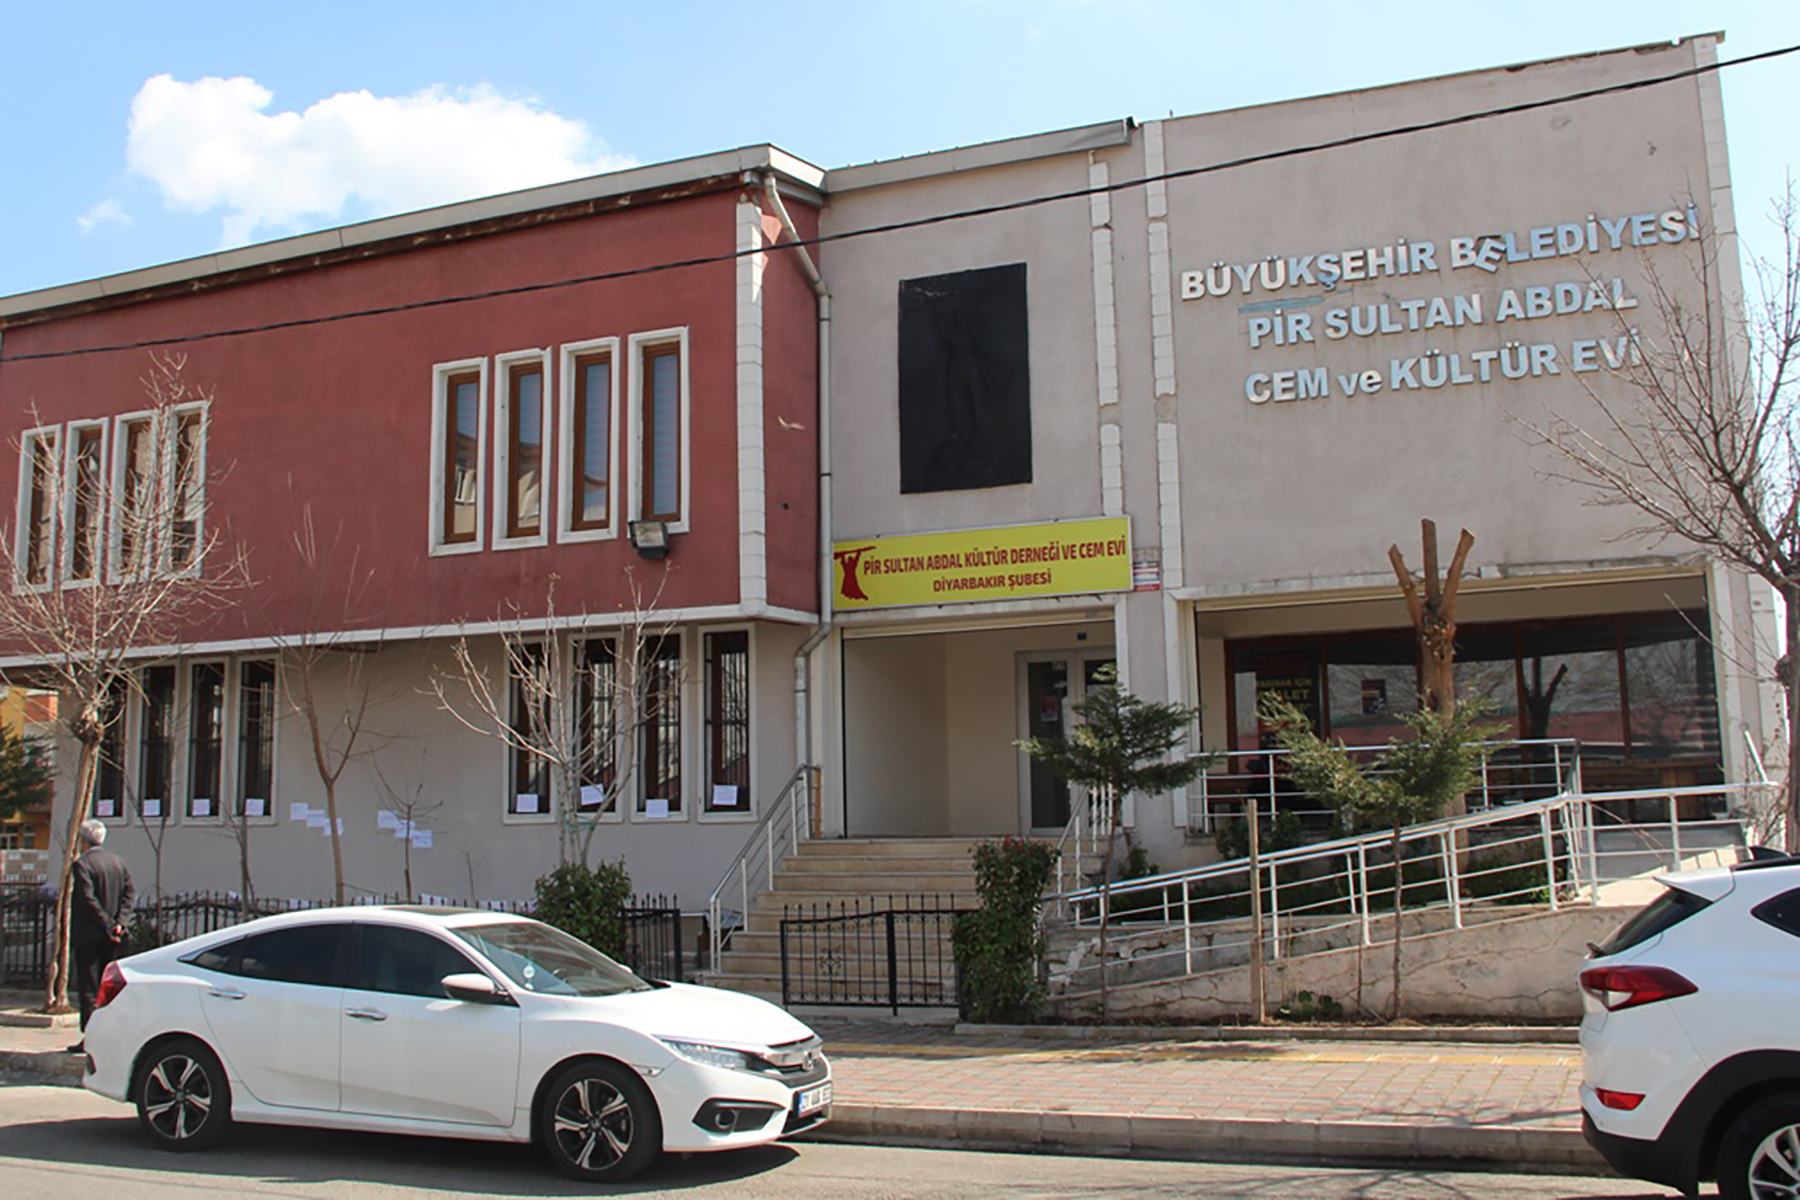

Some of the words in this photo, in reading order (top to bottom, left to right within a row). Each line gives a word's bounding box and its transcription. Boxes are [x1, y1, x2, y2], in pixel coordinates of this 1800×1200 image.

[1181, 238, 1439, 301] BÜYÜKŞEHİR
[1450, 201, 1700, 273] BELEDİYESİ
[1248, 308, 1315, 349] PİR
[1325, 293, 1483, 339] SULTAN
[1496, 277, 1638, 322] ABDAL
[1245, 367, 1329, 404] CEM
[1337, 369, 1383, 398] ve
[1390, 341, 1561, 391] KÜLTÜR
[1572, 327, 1642, 373] EVİ
[864, 555, 882, 576] PİR
[883, 557, 925, 574] SULTAN
[926, 553, 963, 571] ABDAL
[964, 546, 1009, 568] KÜLTÜR
[1010, 541, 1060, 565] DERNEĞİ
[1062, 543, 1078, 560] VE
[1078, 541, 1105, 559] CEM
[1106, 534, 1126, 557] EVİ
[933, 576, 1006, 592] DİYARBAKIR
[1007, 568, 1052, 591] ŞUBESİ
